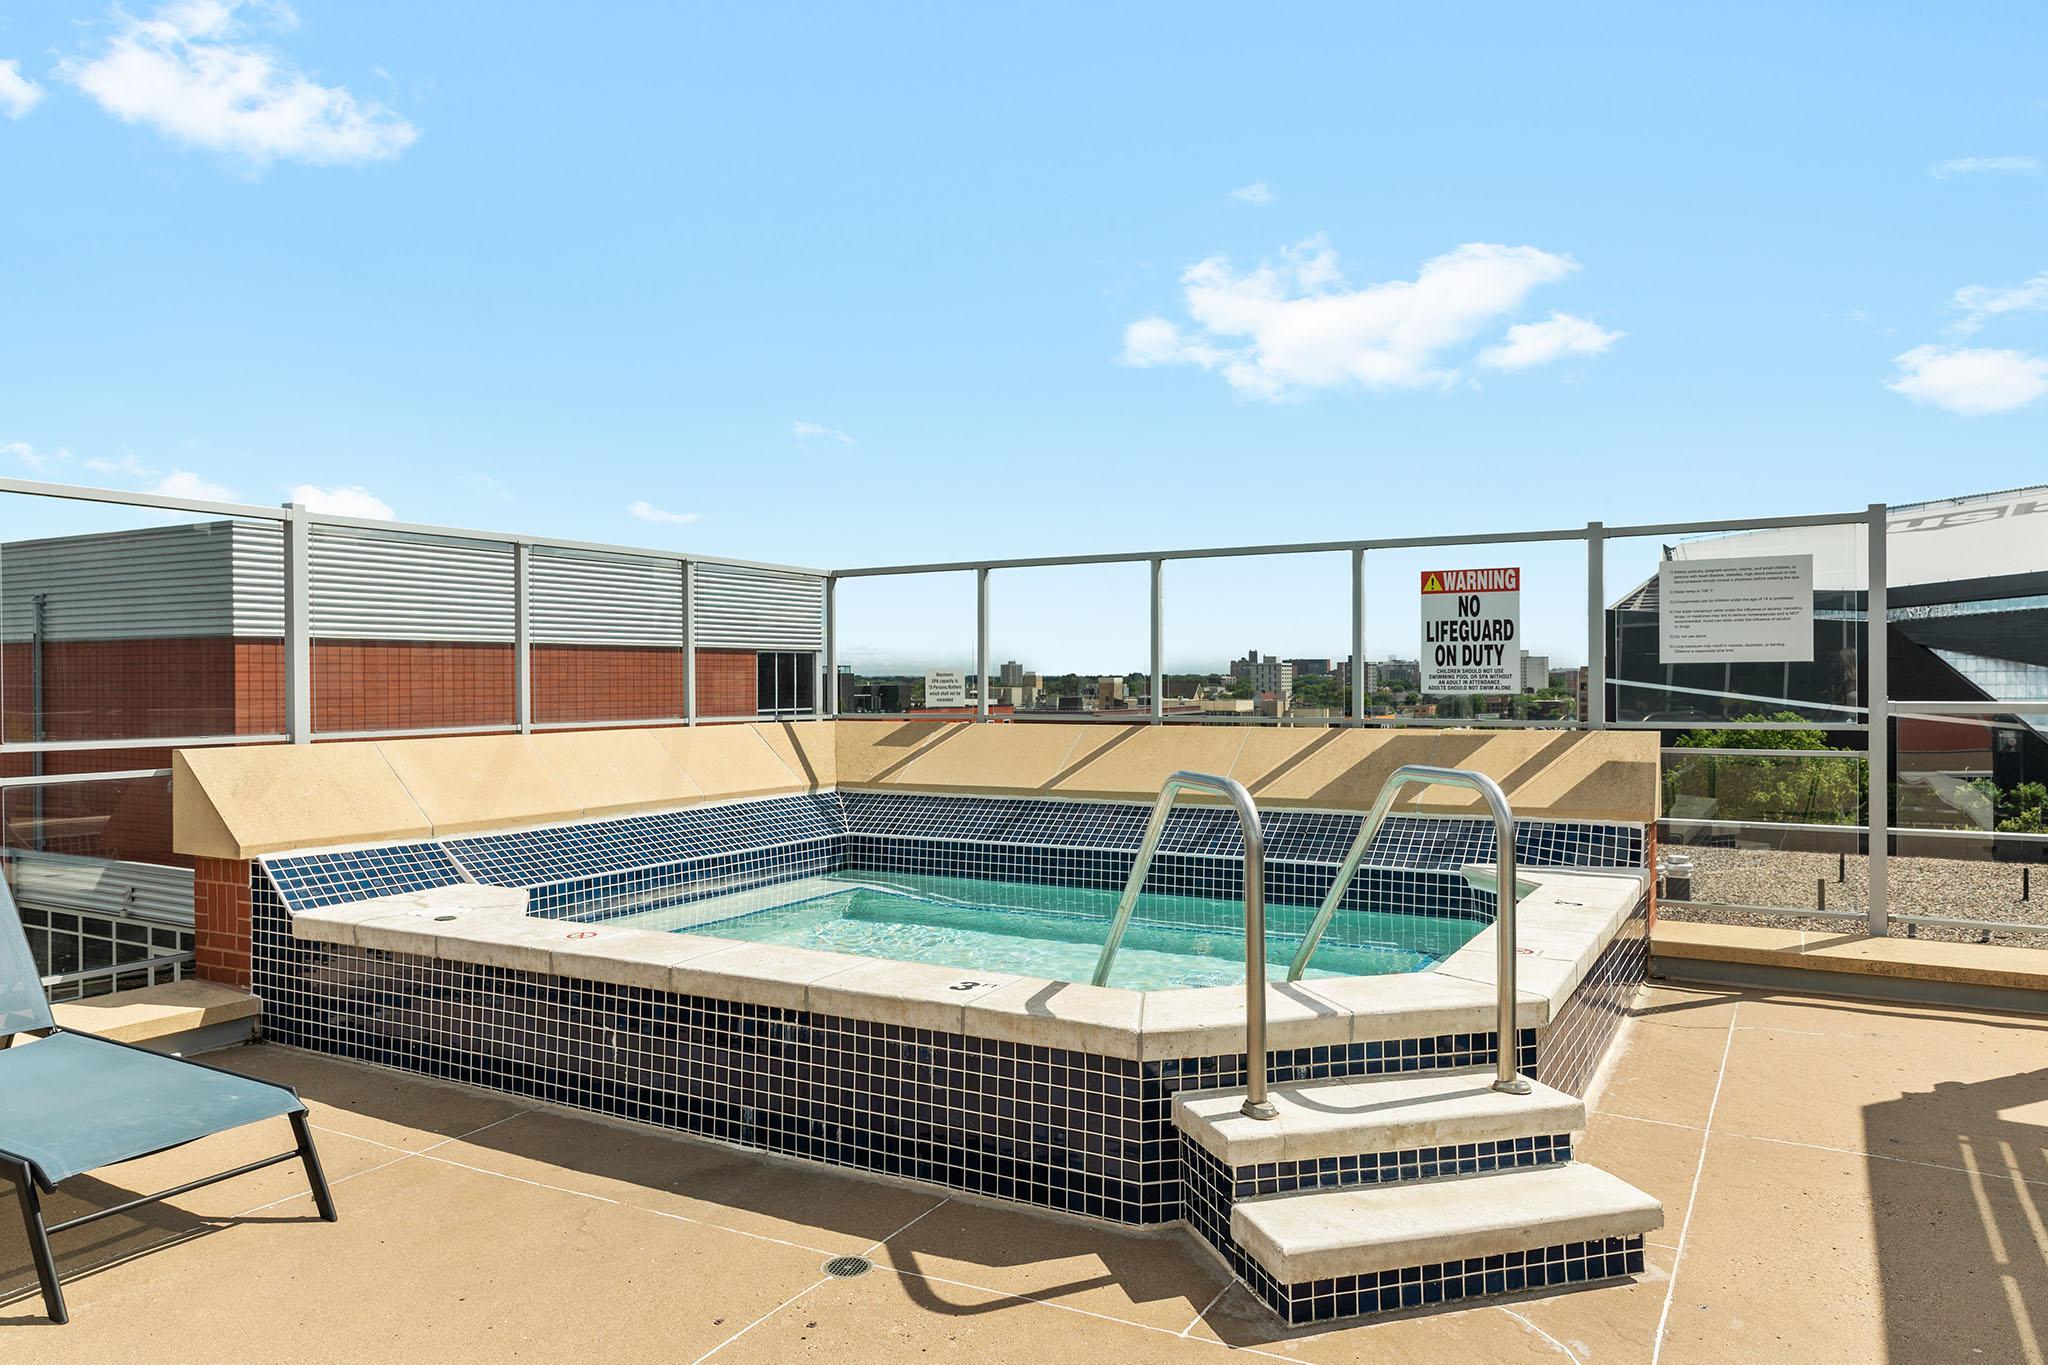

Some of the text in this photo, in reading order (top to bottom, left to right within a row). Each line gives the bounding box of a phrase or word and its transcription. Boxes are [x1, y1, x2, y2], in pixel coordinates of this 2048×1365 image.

[1442, 569, 1517, 591] WARNING
[1458, 594, 1481, 617] NO
[1426, 619, 1514, 643] LIFEGUARD
[1435, 644, 1505, 667] ON DUTY
[949, 981, 980, 991] 3
